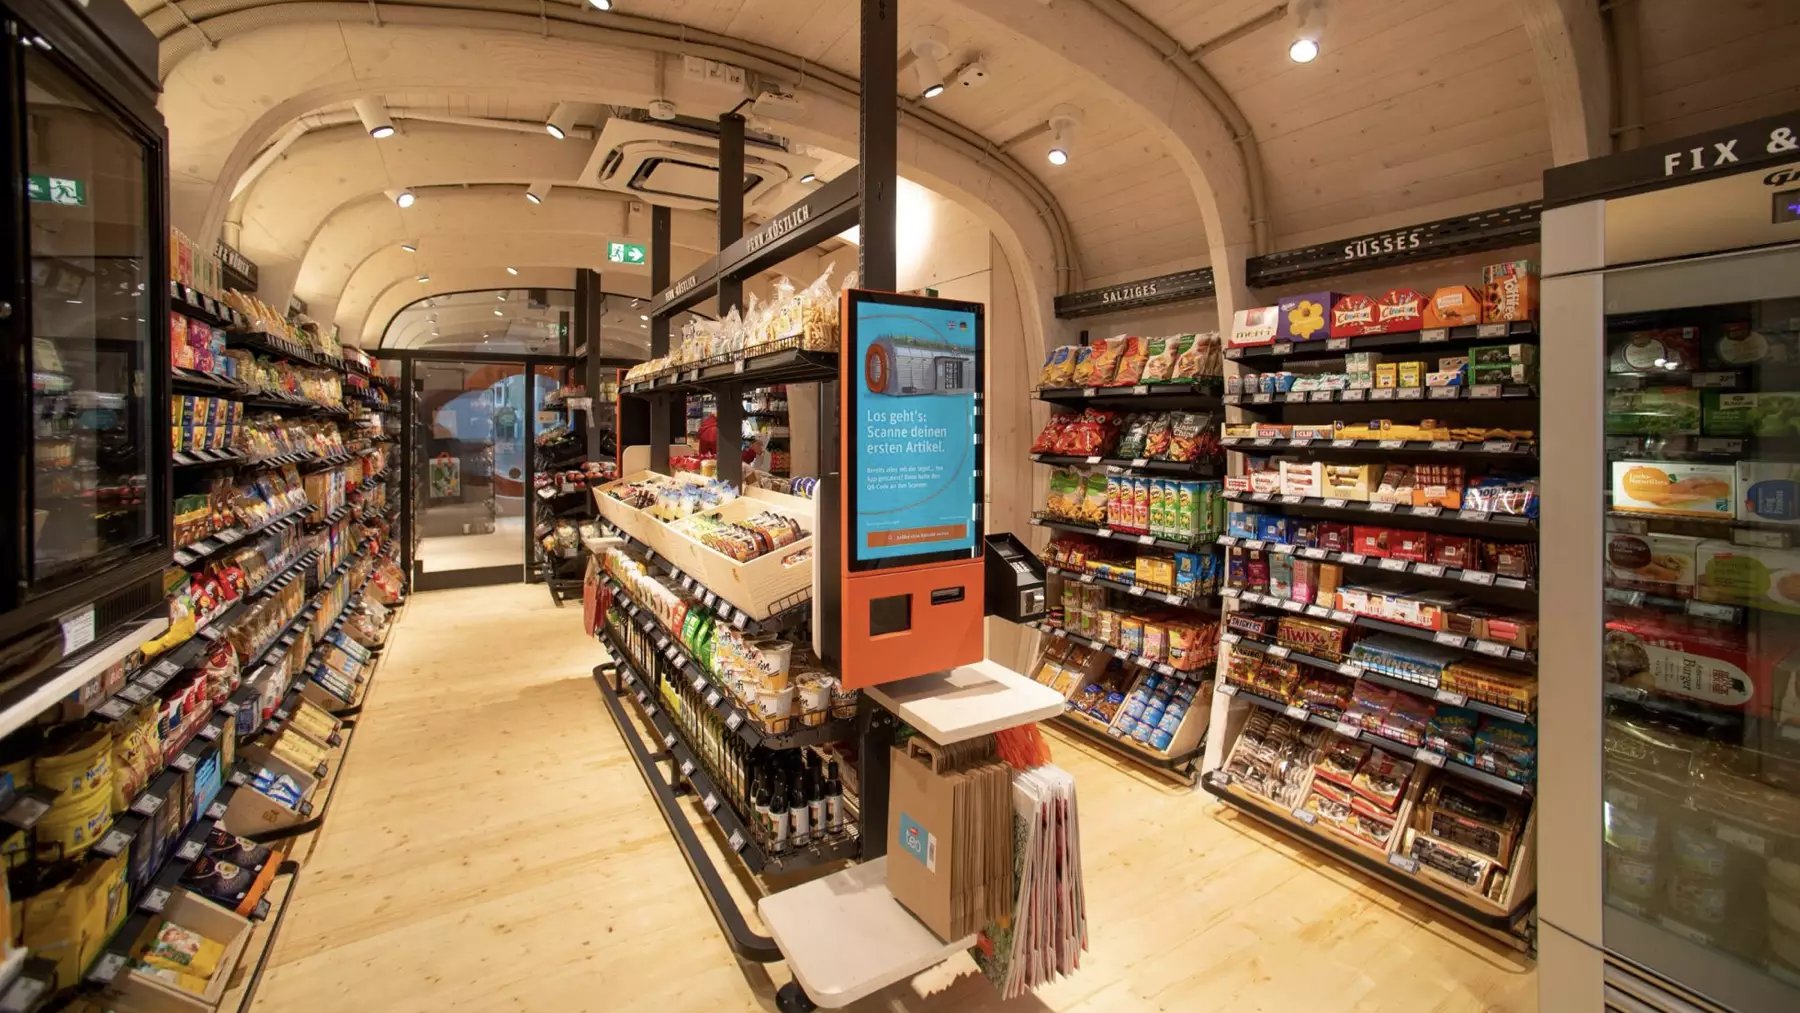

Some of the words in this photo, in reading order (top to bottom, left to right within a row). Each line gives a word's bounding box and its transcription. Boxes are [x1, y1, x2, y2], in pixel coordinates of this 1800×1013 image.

[1664, 139, 1740, 177] FIX
[1766, 127, 1800, 154] &
[1344, 233, 1420, 260] SÜSSES
[1102, 283, 1158, 303] SALZIGES
[1504, 276, 1520, 320] Toffifee
[867, 409, 887, 422] Los
[890, 409, 927, 424] geht's:
[867, 425, 908, 439] Scanne
[911, 424, 947, 438] deinen
[867, 441, 903, 454] ersten
[905, 440, 945, 453] Artikel.
[1231, 617, 1262, 634] SNICKERS
[906, 828, 921, 853] teo
